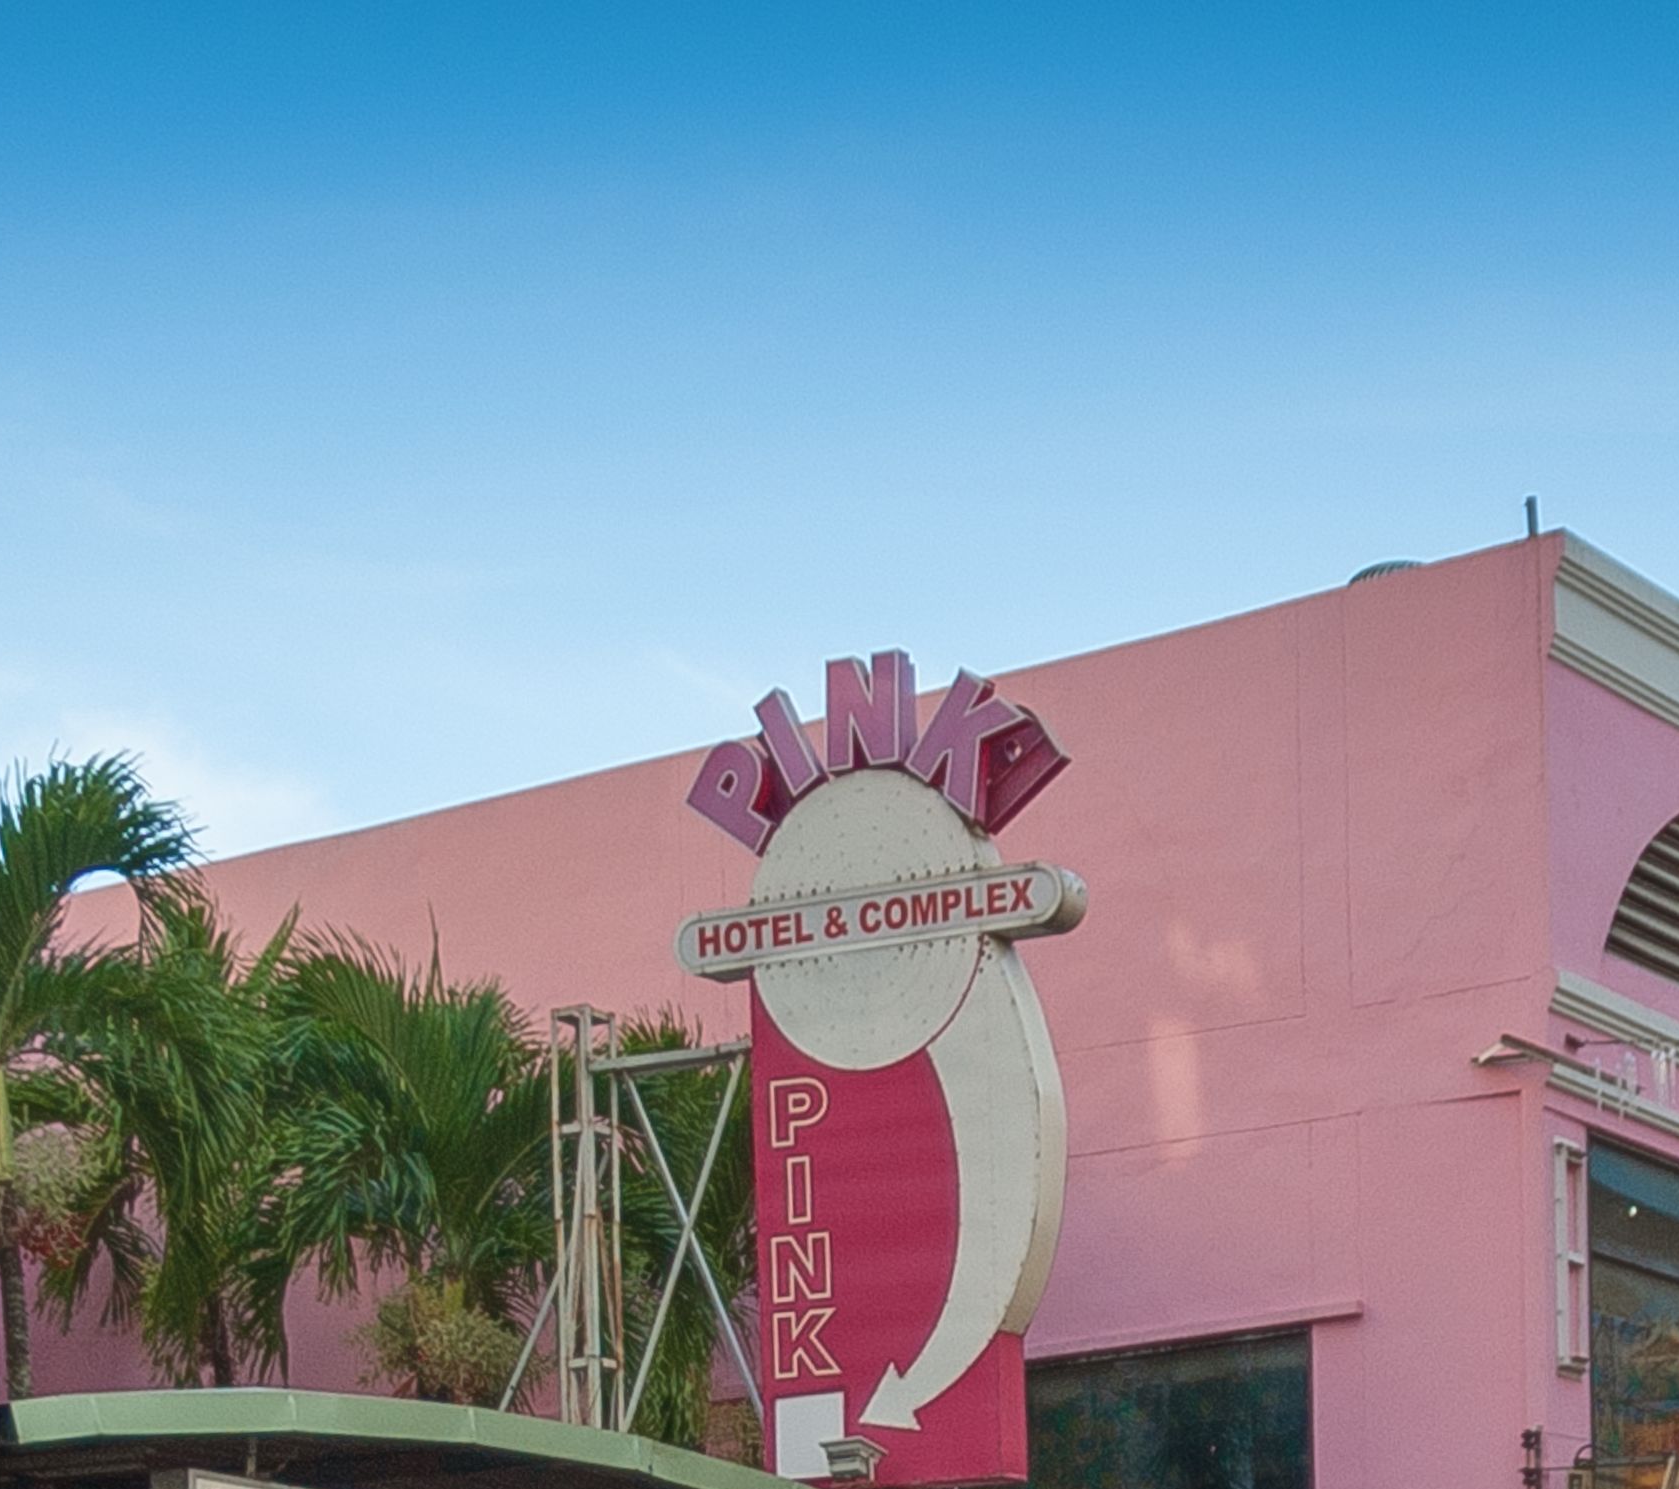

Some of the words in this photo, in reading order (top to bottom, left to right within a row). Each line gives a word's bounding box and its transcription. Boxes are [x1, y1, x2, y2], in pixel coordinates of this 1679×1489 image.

[686, 648, 1064, 857] PINK
[697, 912, 814, 959] HOTEL
[824, 906, 849, 939] &
[859, 878, 1034, 933] COMPLEX
[768, 1077, 842, 1380] PINK
